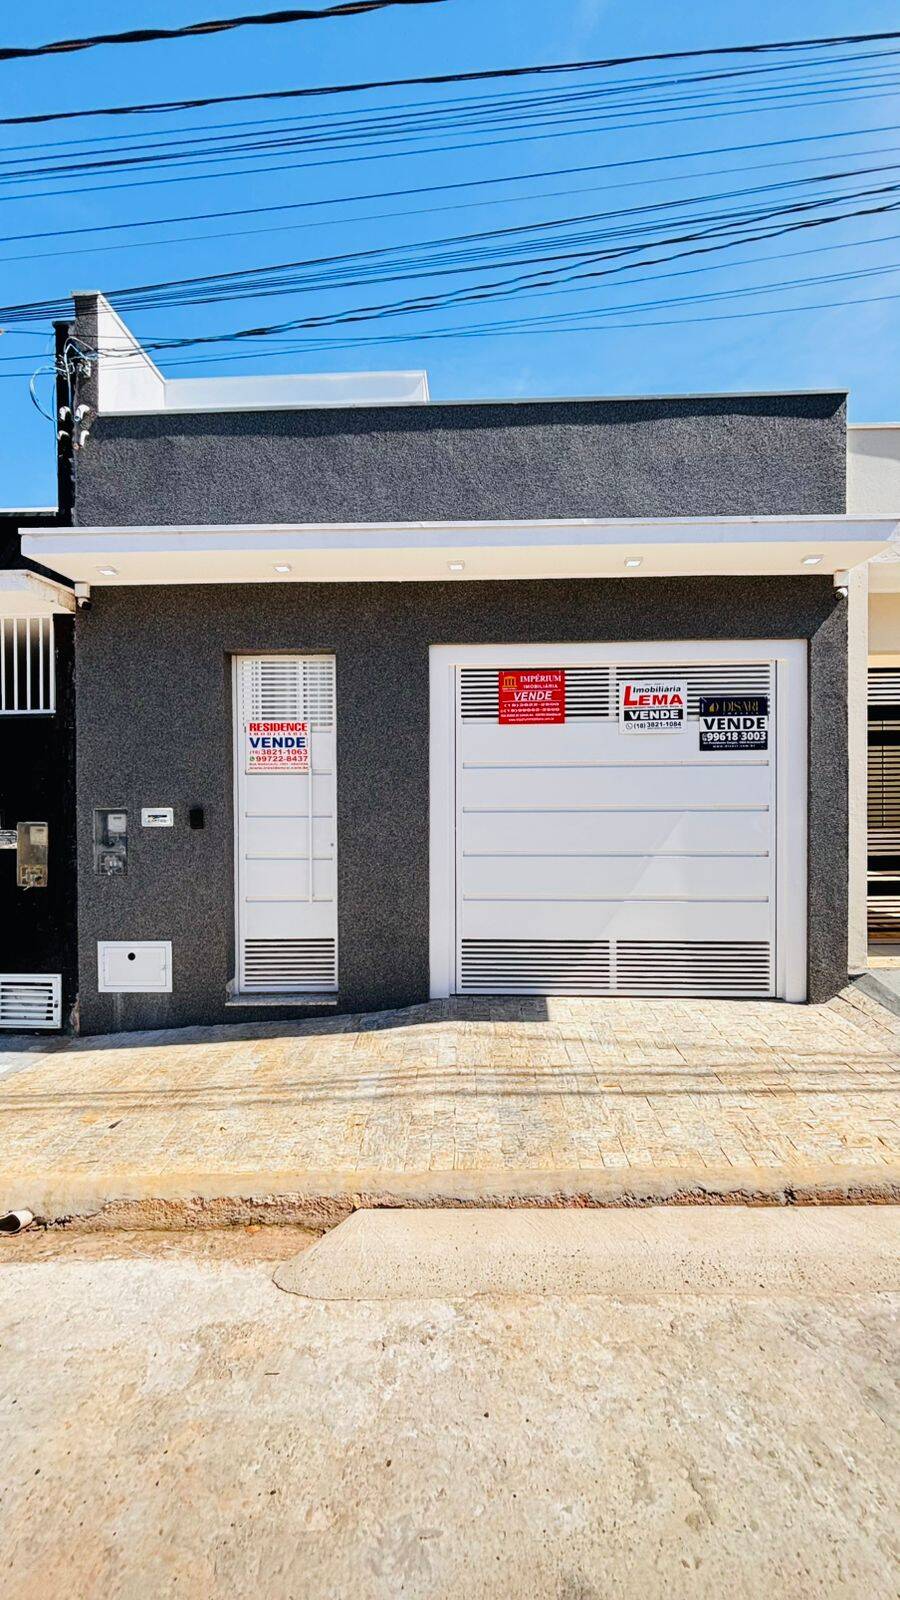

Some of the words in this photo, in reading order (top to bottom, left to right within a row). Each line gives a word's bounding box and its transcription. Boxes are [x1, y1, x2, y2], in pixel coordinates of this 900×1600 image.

[520, 673, 561, 683] IMPÉRIUM
[514, 690, 553, 702] VENDE
[623, 685, 683, 706] LEMA
[629, 710, 679, 720] VENDE
[249, 722, 308, 732] RESIDENCE
[703, 717, 766, 730] VENDE
[249, 737, 306, 748] VENDE
